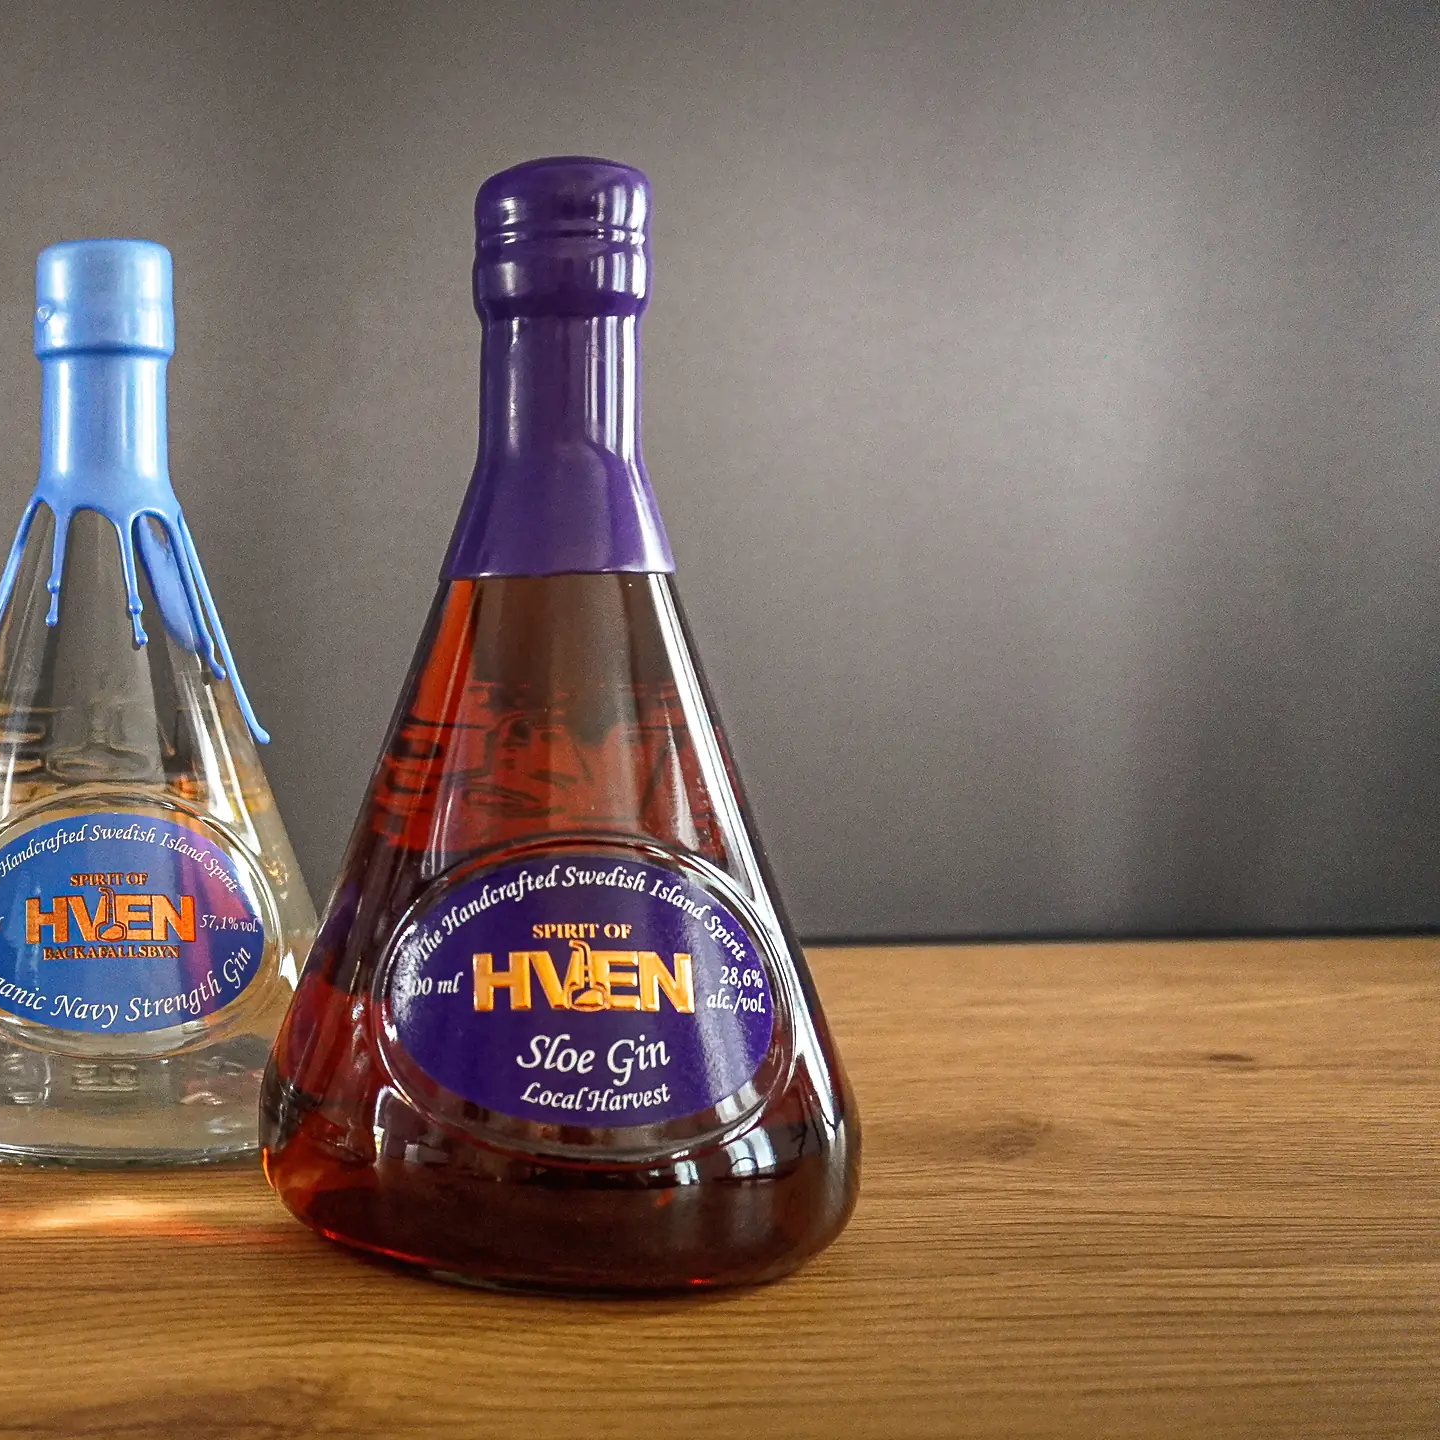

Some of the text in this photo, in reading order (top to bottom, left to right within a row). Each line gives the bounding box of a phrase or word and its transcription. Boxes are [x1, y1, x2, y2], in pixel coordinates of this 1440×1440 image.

[89, 824, 156, 844] Swedish
[160, 832, 211, 864] Island
[204, 856, 239, 894] Spirit
[70, 873, 148, 887] SPIRIT OF
[25, 894, 196, 944] HVEN
[200, 914, 259, 932] 57,1% vol.
[417, 865, 747, 962] The Handcrafted Swedish Island Spirit
[532, 923, 633, 939] SPIRIT OF
[42, 944, 180, 961] BACKAFALLSBYN
[50, 995, 119, 1030] Navy
[125, 977, 222, 1023] Strength
[223, 947, 252, 989] Gin
[409, 971, 464, 997] 00 ml
[472, 950, 697, 1014] HVEN
[719, 965, 763, 989] 28,6%
[706, 987, 766, 1014] alc./vol.
[516, 1034, 671, 1086] Sloe Gin
[519, 1081, 672, 1113] Local Harvest
